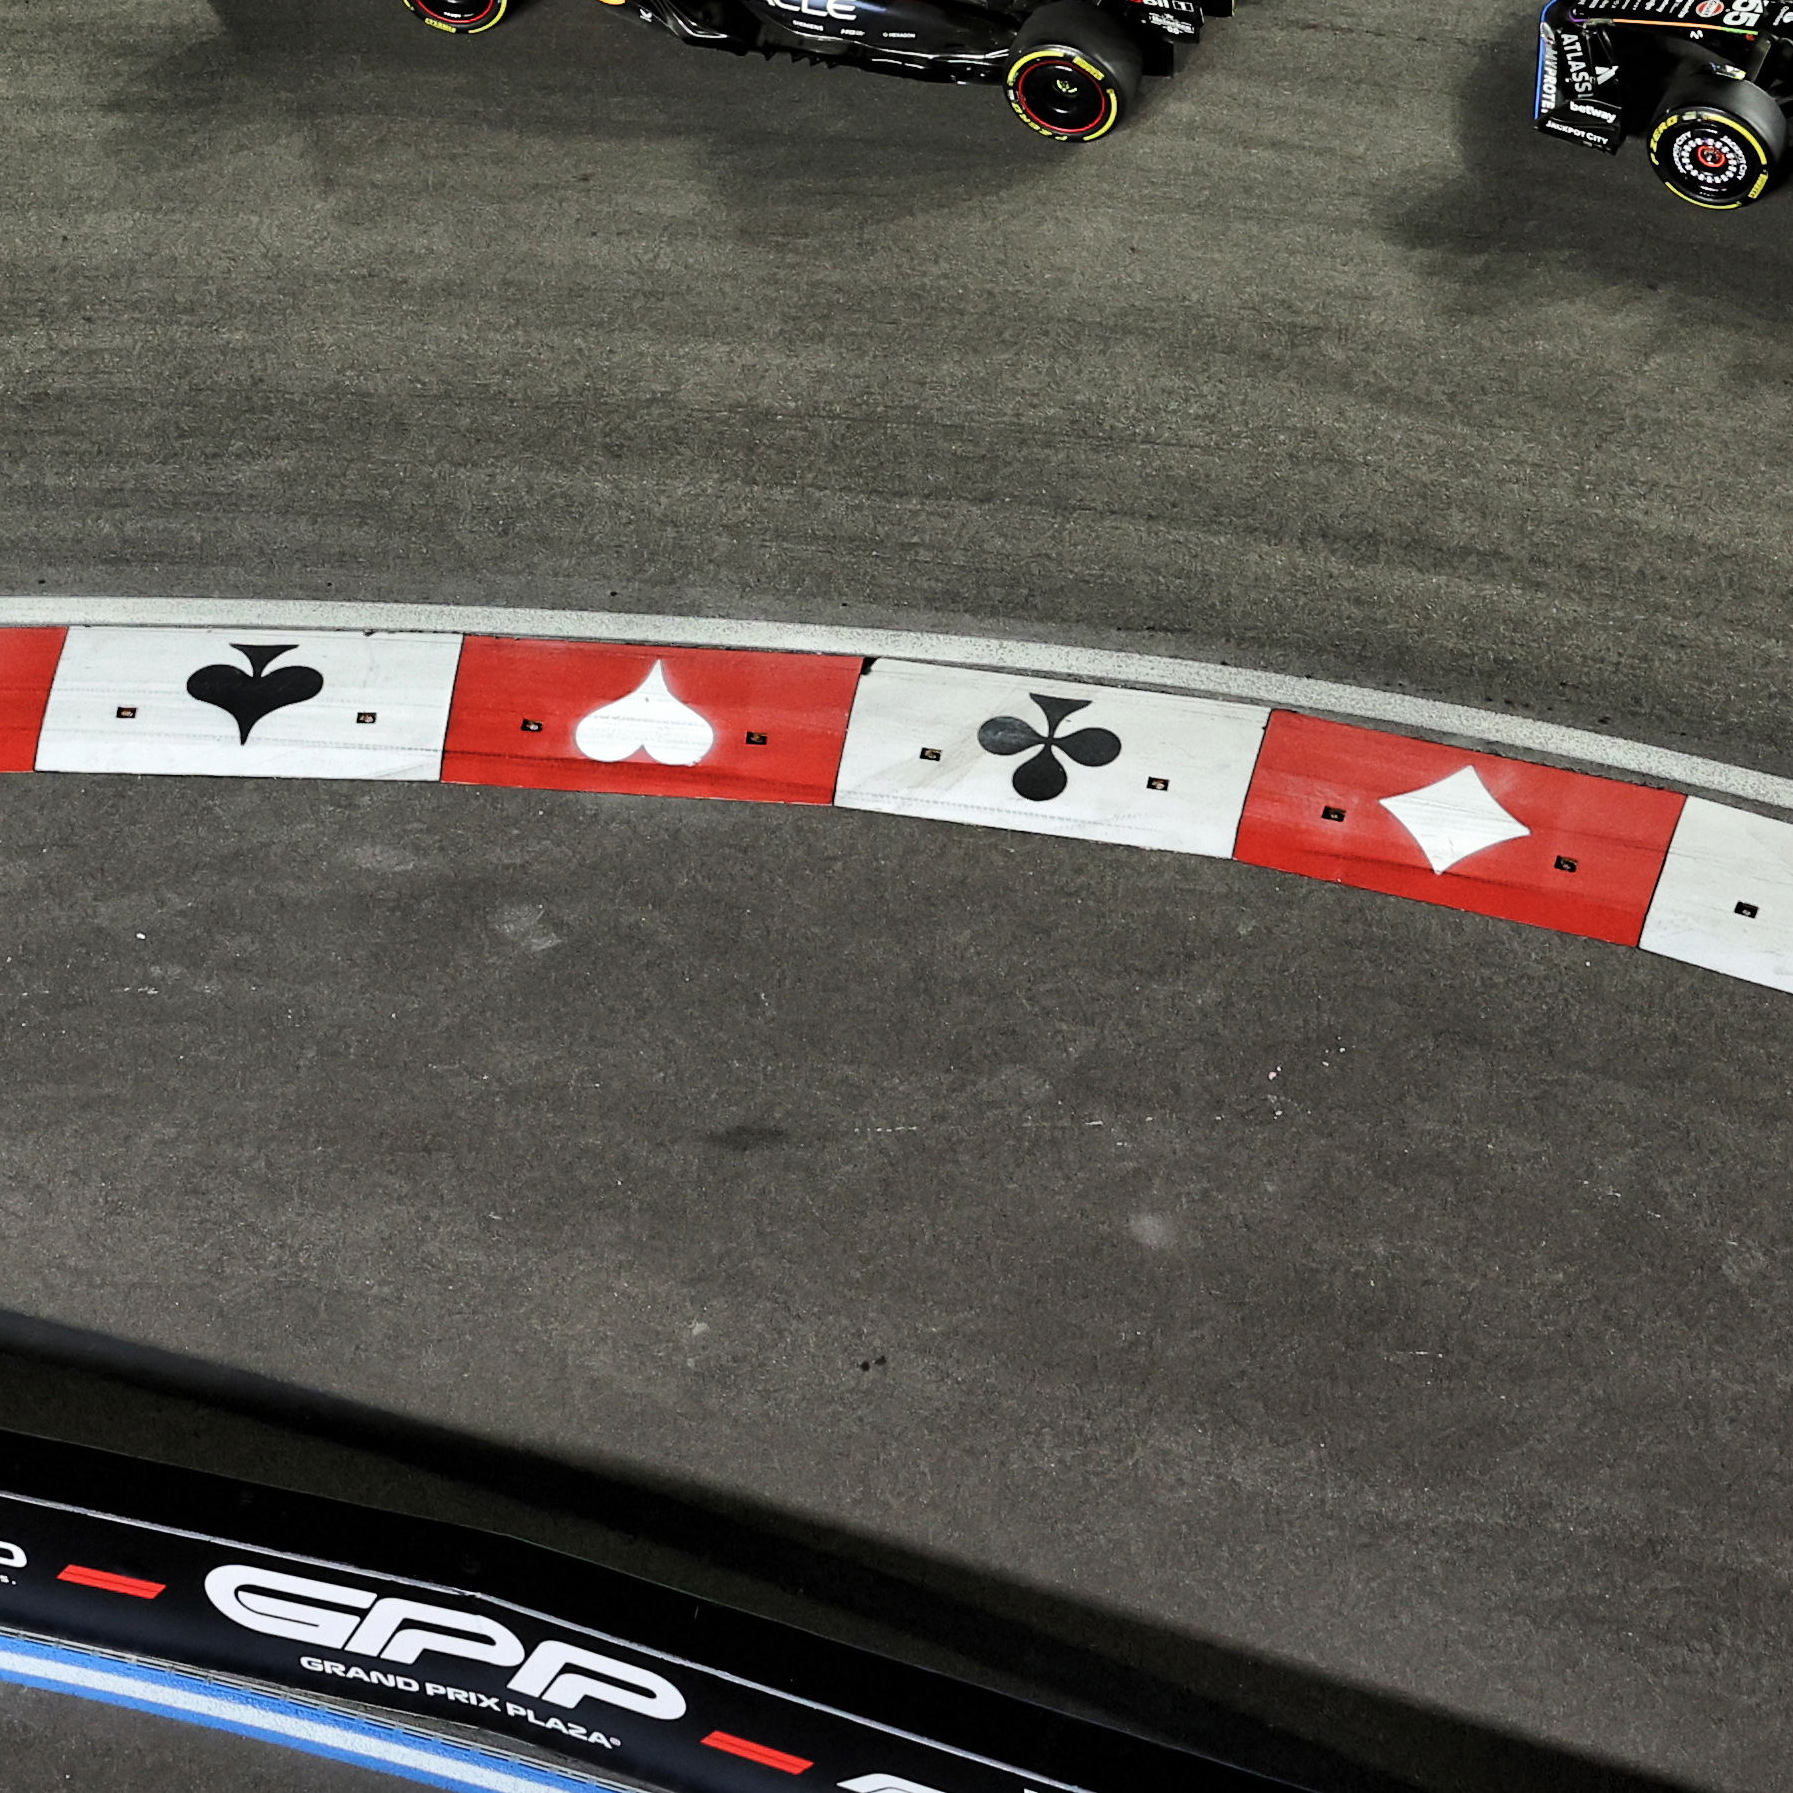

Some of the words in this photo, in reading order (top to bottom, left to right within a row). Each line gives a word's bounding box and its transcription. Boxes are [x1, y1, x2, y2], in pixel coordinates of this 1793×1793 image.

[1569, 101, 1617, 123] betway
[1584, 130, 1609, 145] CITY
[299, 1654, 420, 1692] GRAND
[423, 1679, 501, 1711] PRIX
[506, 1701, 612, 1748] PLAZA
